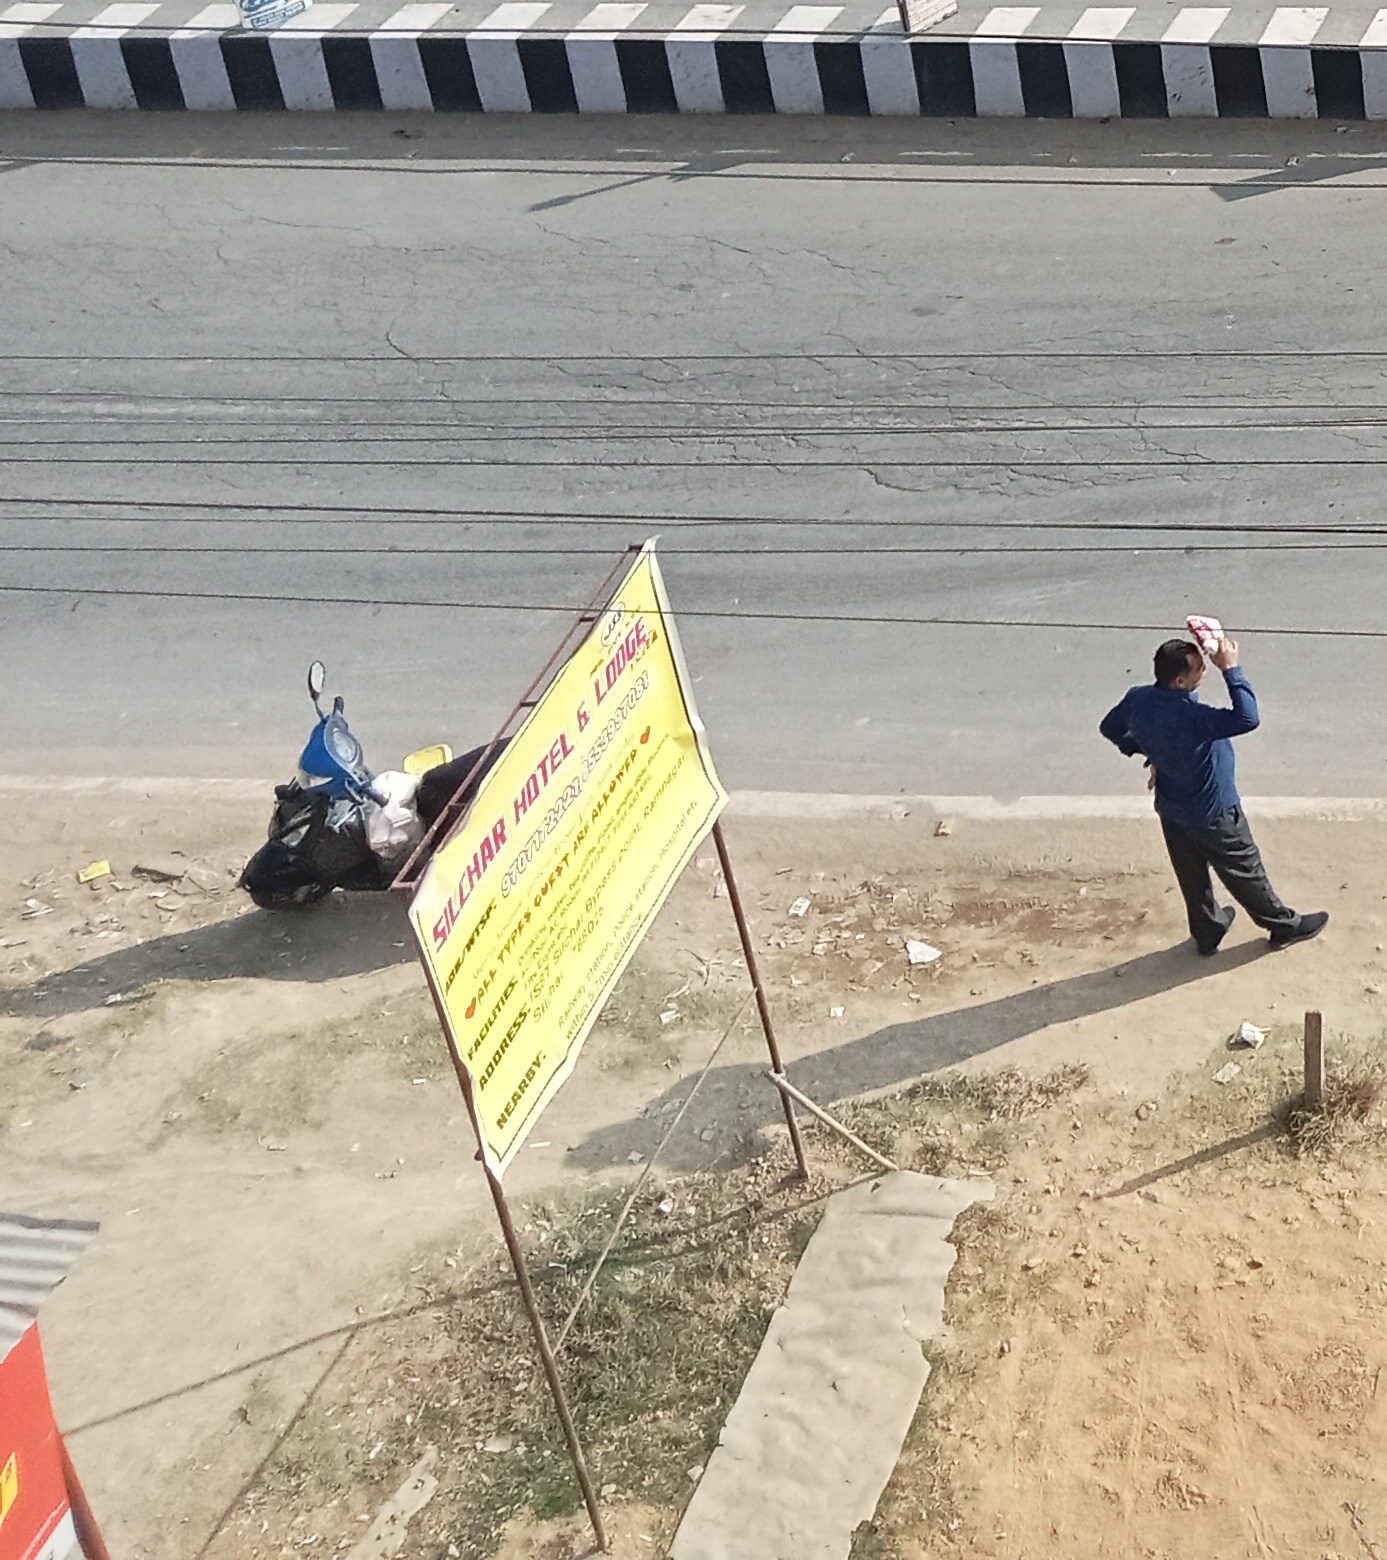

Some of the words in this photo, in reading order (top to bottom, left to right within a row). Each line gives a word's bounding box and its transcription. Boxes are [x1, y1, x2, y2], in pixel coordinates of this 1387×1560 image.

[432, 817, 506, 951] SILCHAR
[513, 733, 574, 824] HOTEL
[576, 700, 590, 732] &
[594, 616, 648, 706] LODGE
[477, 969, 496, 1005] ALL
[497, 907, 531, 963] TYPES
[533, 852, 569, 907] GUEST
[573, 820, 589, 855] ARE
[591, 748, 637, 823] ALLOWED
[467, 976, 517, 1060] FACILITIES:
[479, 1002, 530, 1091] ADDRESS:
[552, 914, 583, 964] Silchar
[585, 860, 615, 913] Bypass
[496, 1050, 545, 1129] NEARBY:
[558, 985, 585, 1027] Railway
[586, 942, 613, 981] station,
[613, 903, 633, 937] Police
[635, 864, 658, 899] station,
[659, 813, 685, 859] Hospital
[566, 1003, 588, 1039] within
[613, 913, 641, 960] distance
